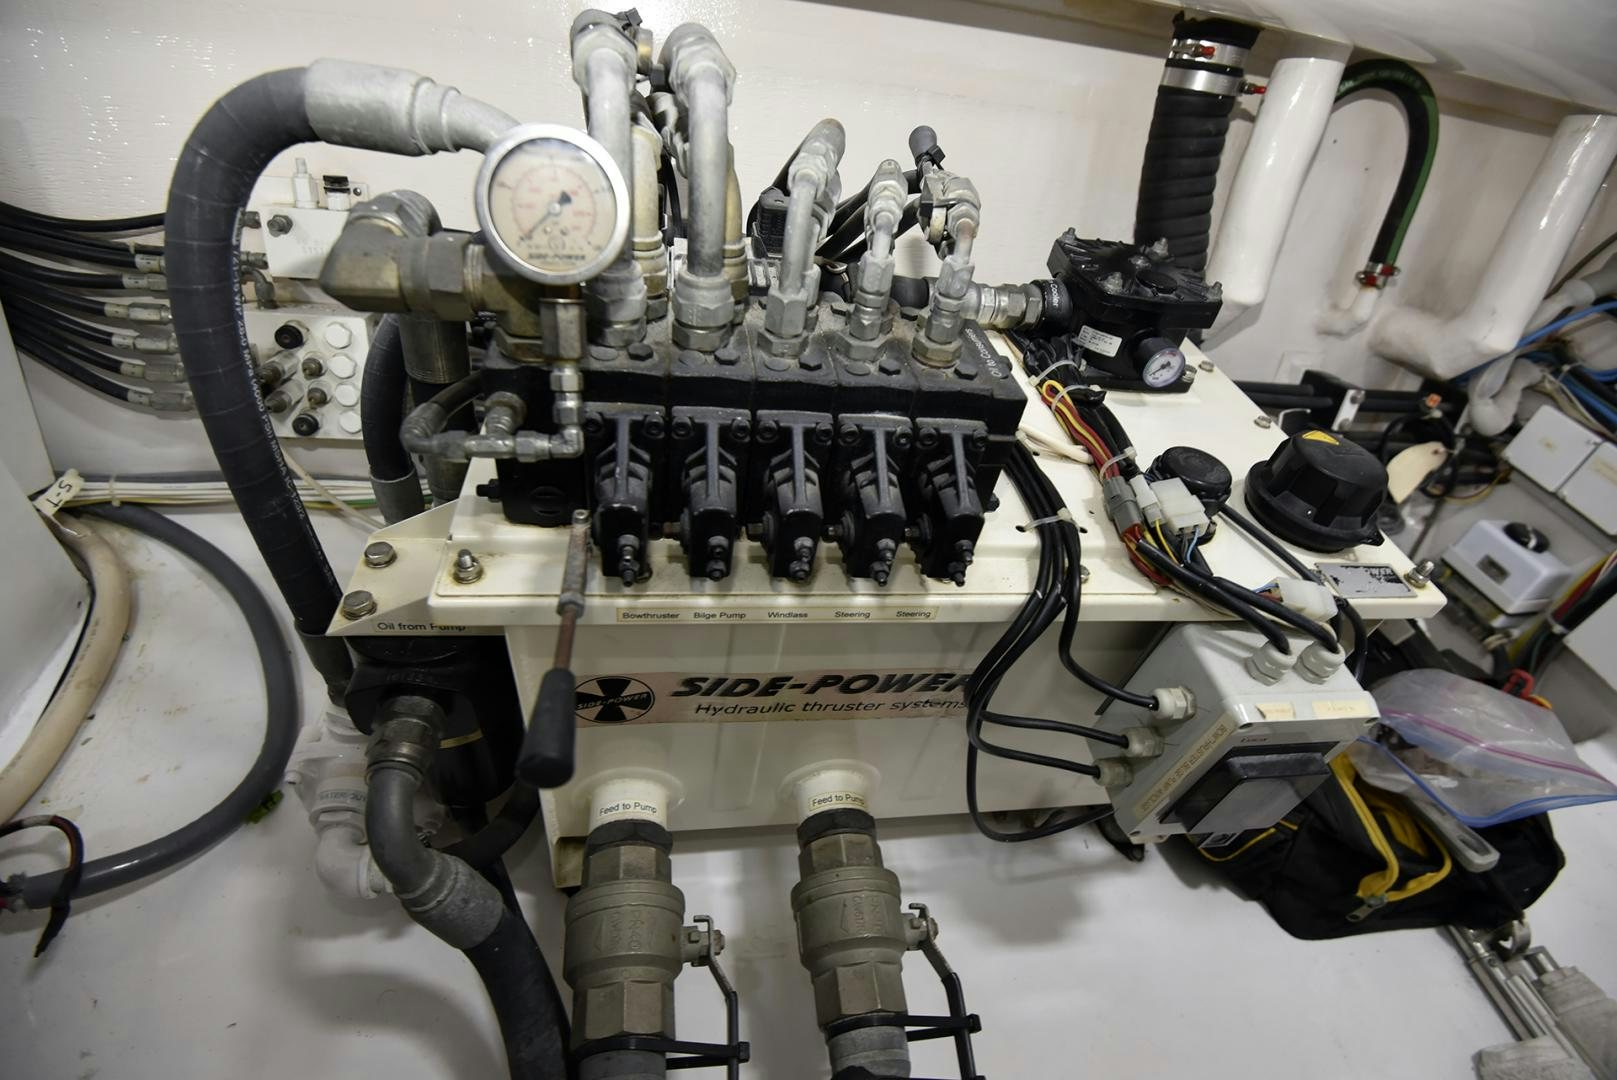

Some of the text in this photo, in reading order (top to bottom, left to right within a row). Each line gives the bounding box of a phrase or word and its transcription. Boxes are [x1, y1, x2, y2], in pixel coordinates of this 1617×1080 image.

[1050, 280, 1060, 308] Cooler
[622, 609, 931, 620] Bowthruster Bilge Pump Windlass Steering Steering
[376, 622, 396, 631] Oil
[398, 622, 428, 631] from
[694, 699, 968, 717] Hydraulic thruster systems
[811, 795, 833, 808] Feed
[834, 794, 845, 802] to
[599, 801, 658, 817] Feed to Pump
